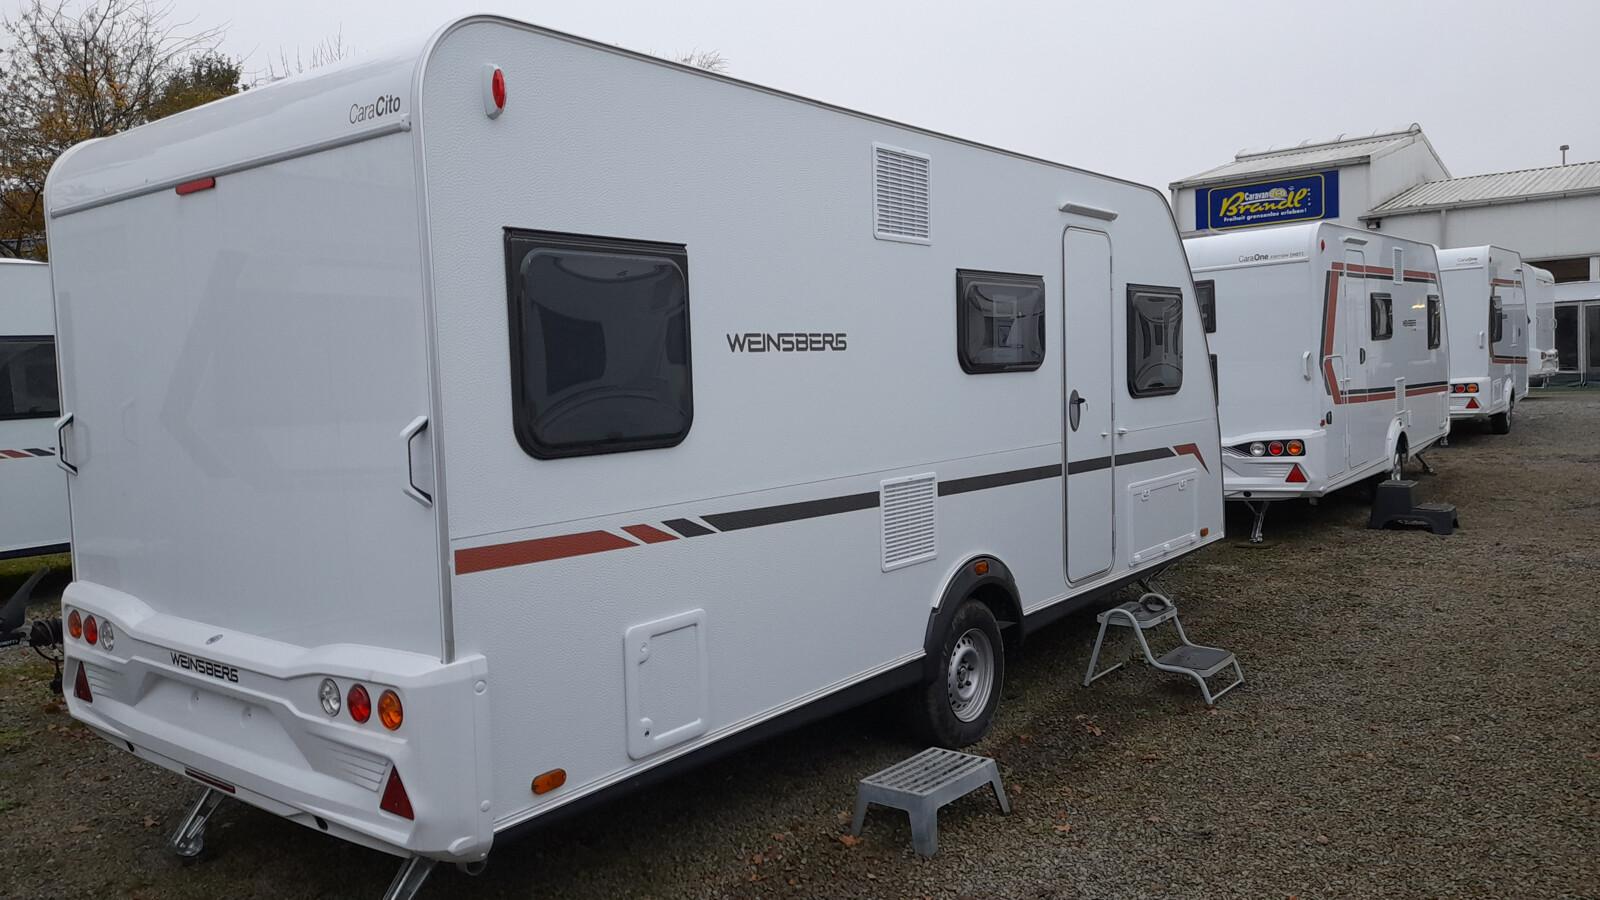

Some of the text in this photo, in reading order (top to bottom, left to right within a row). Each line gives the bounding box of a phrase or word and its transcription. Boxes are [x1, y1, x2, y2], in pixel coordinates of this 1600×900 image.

[349, 94, 400, 124] CaraCito
[1219, 188, 1308, 216] Brandl
[1244, 191, 1269, 201] Caravan
[1239, 254, 1269, 262] CaraOne
[726, 333, 847, 352] WEINSBERG
[170, 652, 239, 683] WEINSBERG
